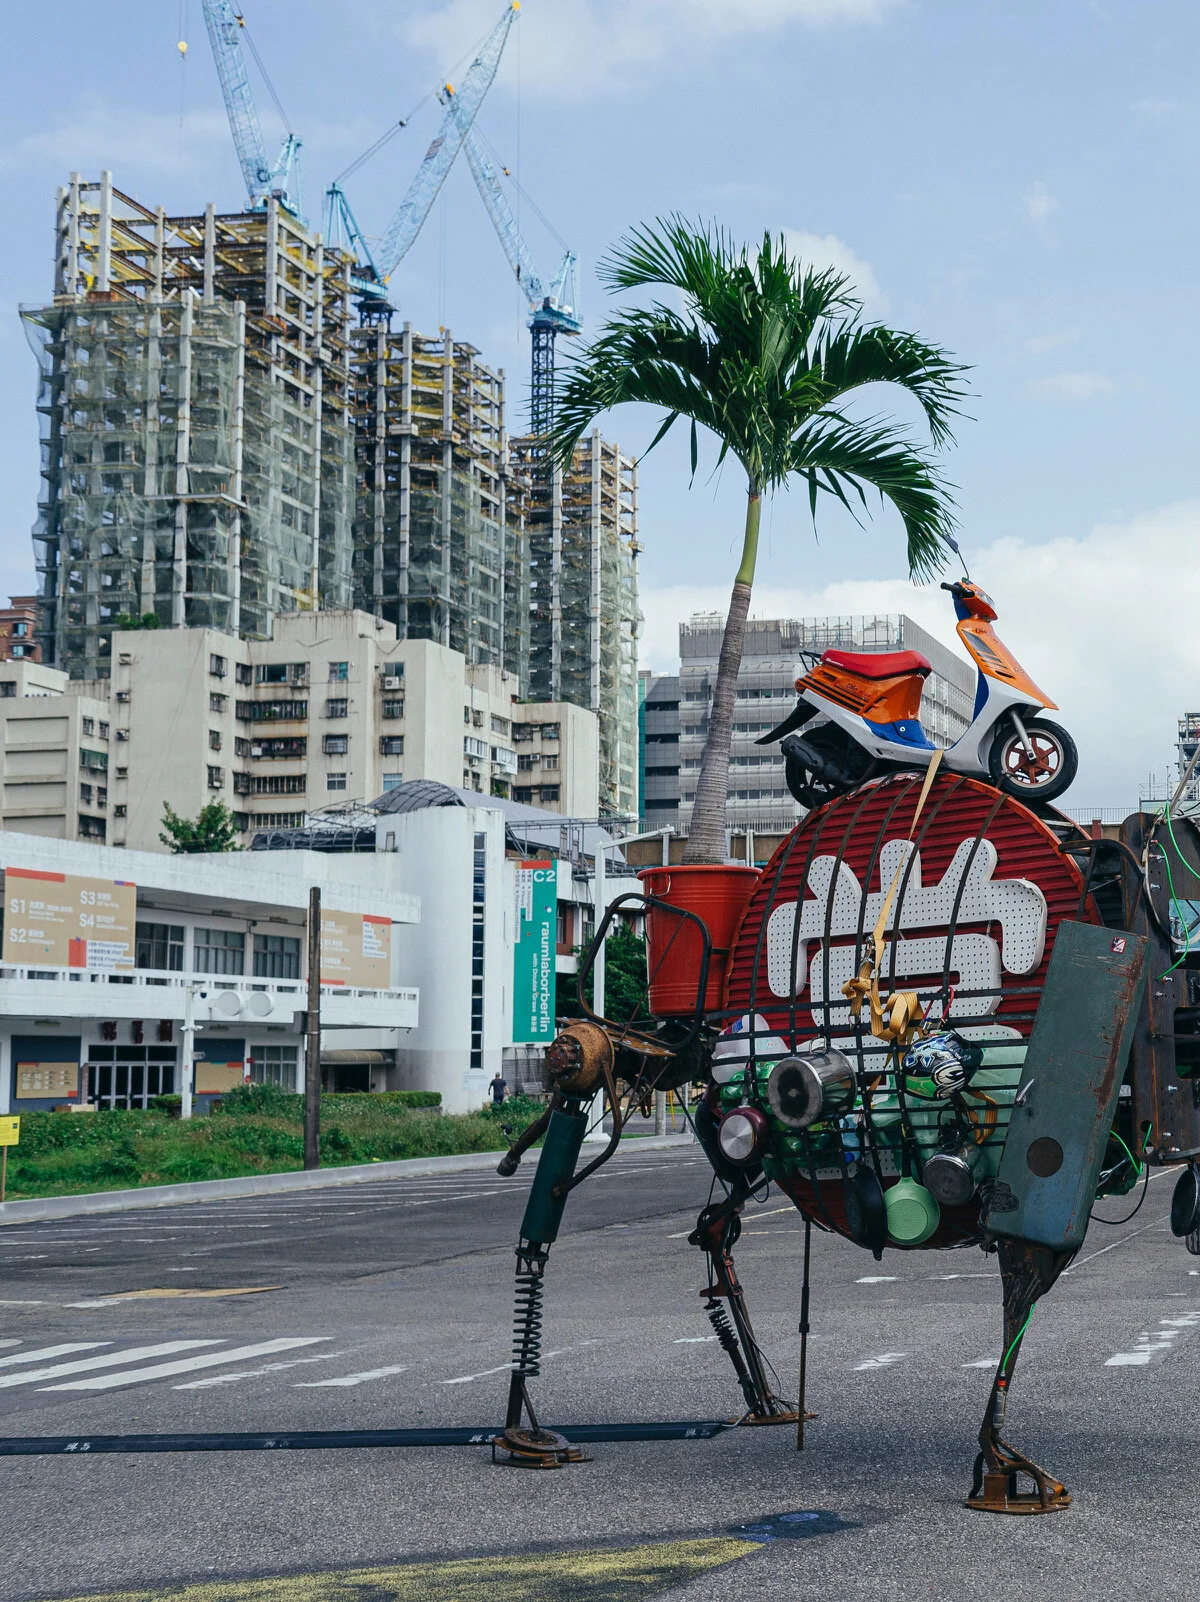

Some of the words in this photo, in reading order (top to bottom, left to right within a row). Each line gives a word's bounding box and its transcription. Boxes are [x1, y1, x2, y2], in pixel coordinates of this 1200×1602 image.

[533, 870, 556, 882] C2
[80, 890, 95, 905] S3
[10, 898, 25, 913] S1
[79, 913, 95, 927] S4
[9, 928, 26, 943] S2
[540, 921, 551, 1032] raumlaborberlin
